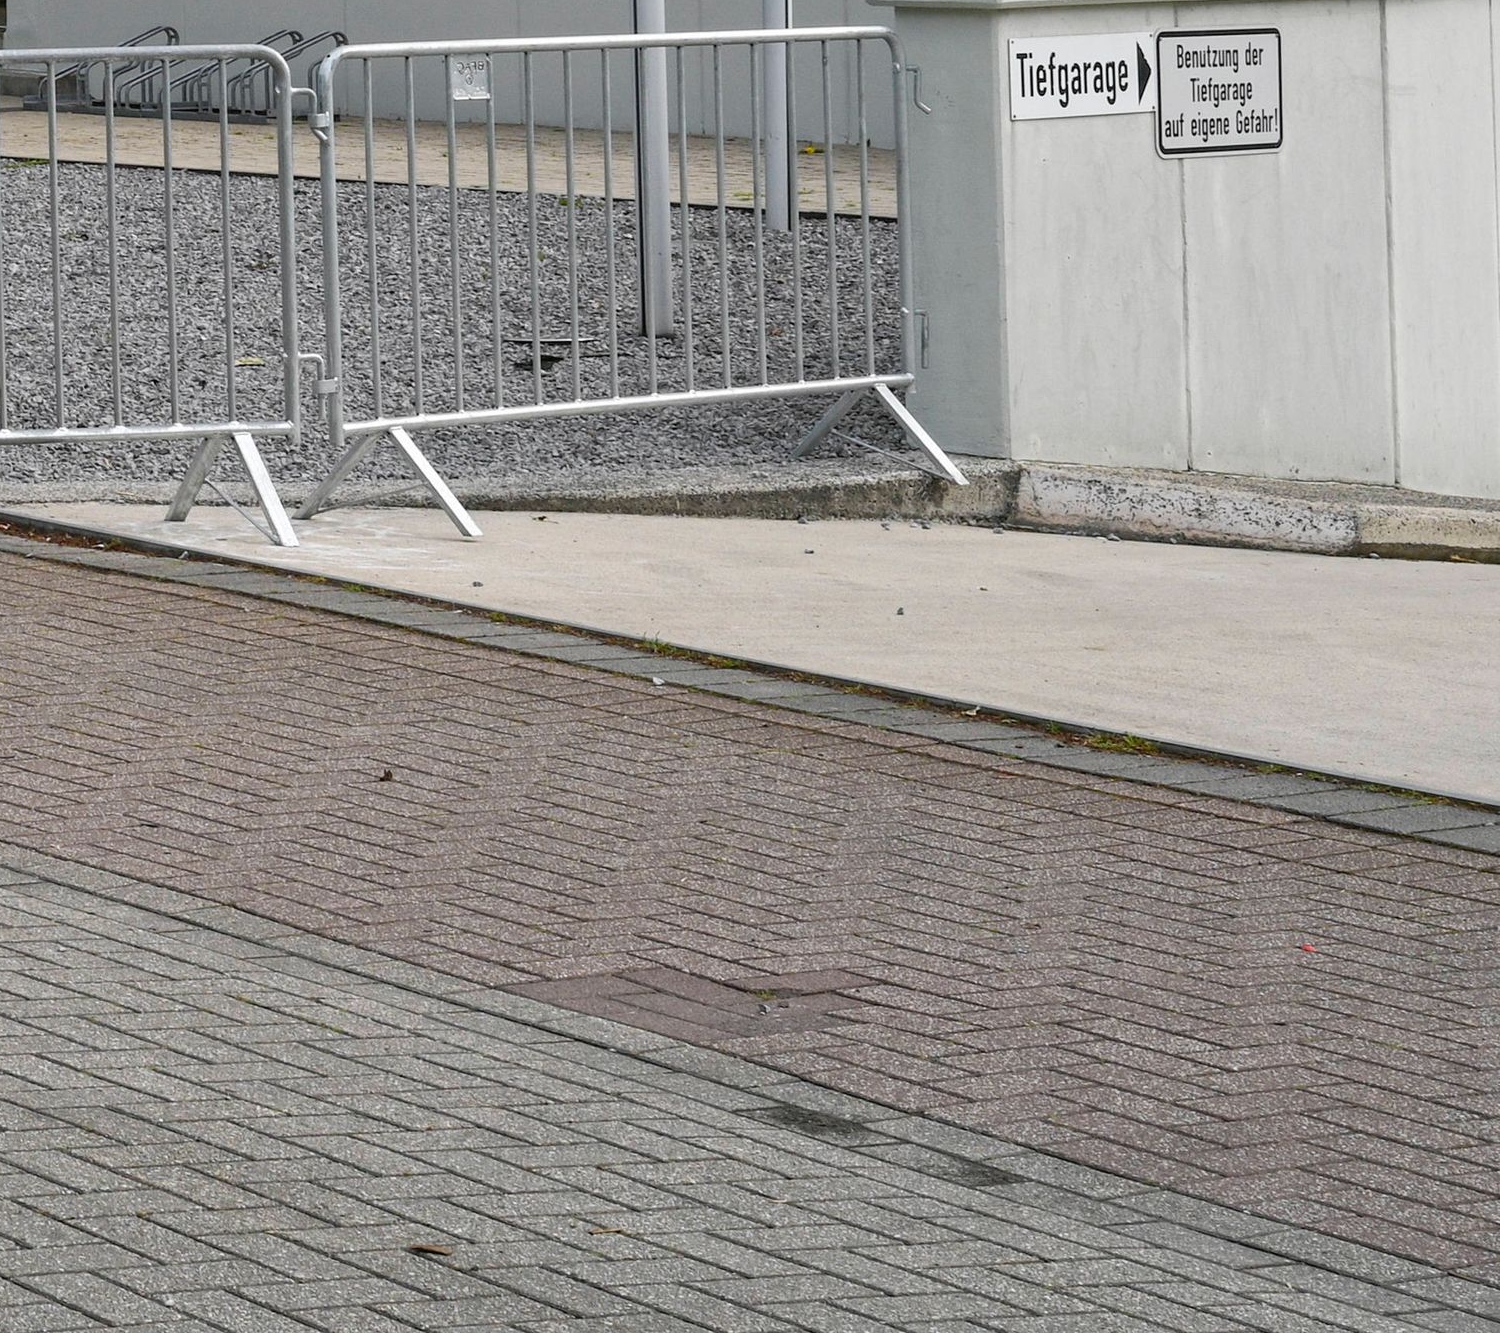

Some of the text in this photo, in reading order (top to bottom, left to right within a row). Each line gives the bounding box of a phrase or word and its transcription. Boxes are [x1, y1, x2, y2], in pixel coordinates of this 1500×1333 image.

[1176, 42, 1264, 73] Benutzung der
[1016, 52, 1129, 108] Tiefgarage
[1190, 78, 1253, 108] Tiefgarage
[1164, 108, 1279, 143] auf eigene Gefahr!
